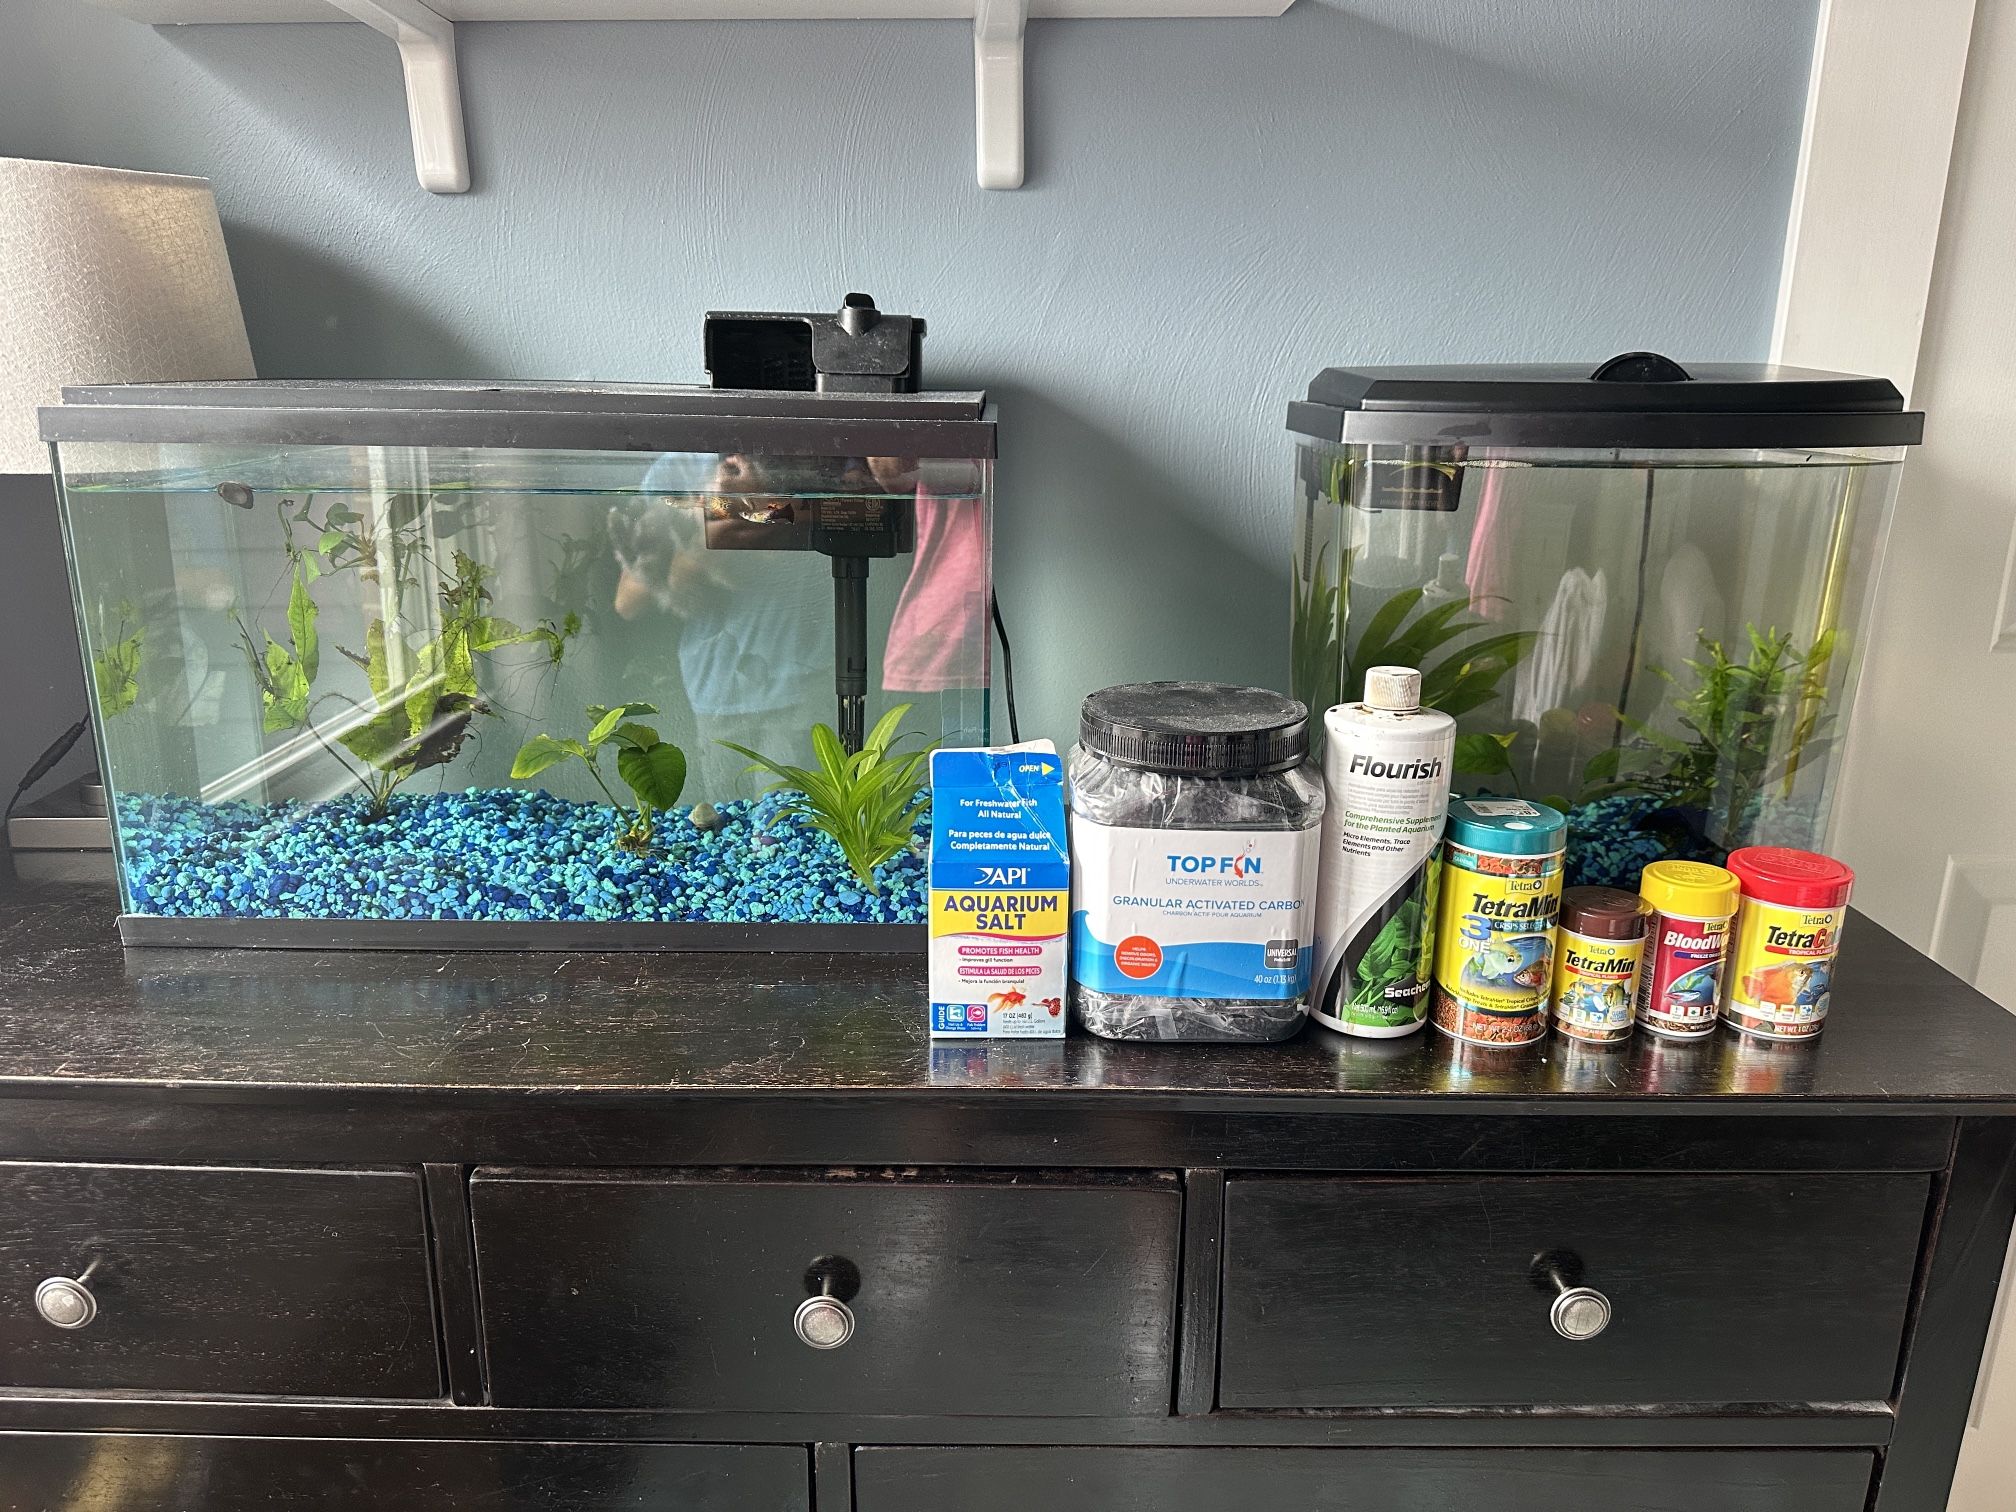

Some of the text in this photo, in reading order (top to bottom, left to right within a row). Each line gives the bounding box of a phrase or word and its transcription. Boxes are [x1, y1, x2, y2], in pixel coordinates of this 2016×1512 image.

[1018, 764, 1040, 773] OPEN
[1350, 754, 1442, 780] Flourish
[960, 799, 974, 807] For
[975, 798, 1020, 808] Freshwater
[978, 810, 1022, 819] All Natural
[1345, 810, 1404, 825] Comprehensive
[1356, 821, 1370, 830] the
[1370, 824, 1402, 834] Planted
[948, 829, 1051, 841] Para peces de agua dulce
[1344, 832, 1360, 840] Micro
[950, 841, 1050, 852] Completamente Natural
[1342, 838, 1371, 850] Elements
[1342, 846, 1371, 856] Nutrients
[1167, 856, 1216, 873] TOP
[988, 868, 1026, 885] API
[1165, 878, 1260, 887] UNDERWATER WORLDS
[1510, 881, 1532, 891] Tetra
[944, 896, 1058, 912] AQUARIUM
[1113, 895, 1182, 908] GRANULAR
[1186, 898, 1254, 910] ACTIVATED
[1472, 893, 1559, 918] TetraMin
[976, 914, 1026, 930] SALT
[1803, 914, 1824, 925] Tetra
[1460, 915, 1492, 940] 3
[1706, 922, 1724, 931] Tetra
[961, 947, 1040, 955] PROMOTES FISH HEALTH
[1459, 937, 1491, 954] ONE
[1589, 946, 1607, 955] Tetra
[1566, 949, 1636, 973] TetraMin
[960, 967, 983, 975] ESTIMULA
[1254, 975, 1262, 984] 40
[1472, 1022, 1486, 1031] NET
[1774, 1025, 1786, 1033] NET
